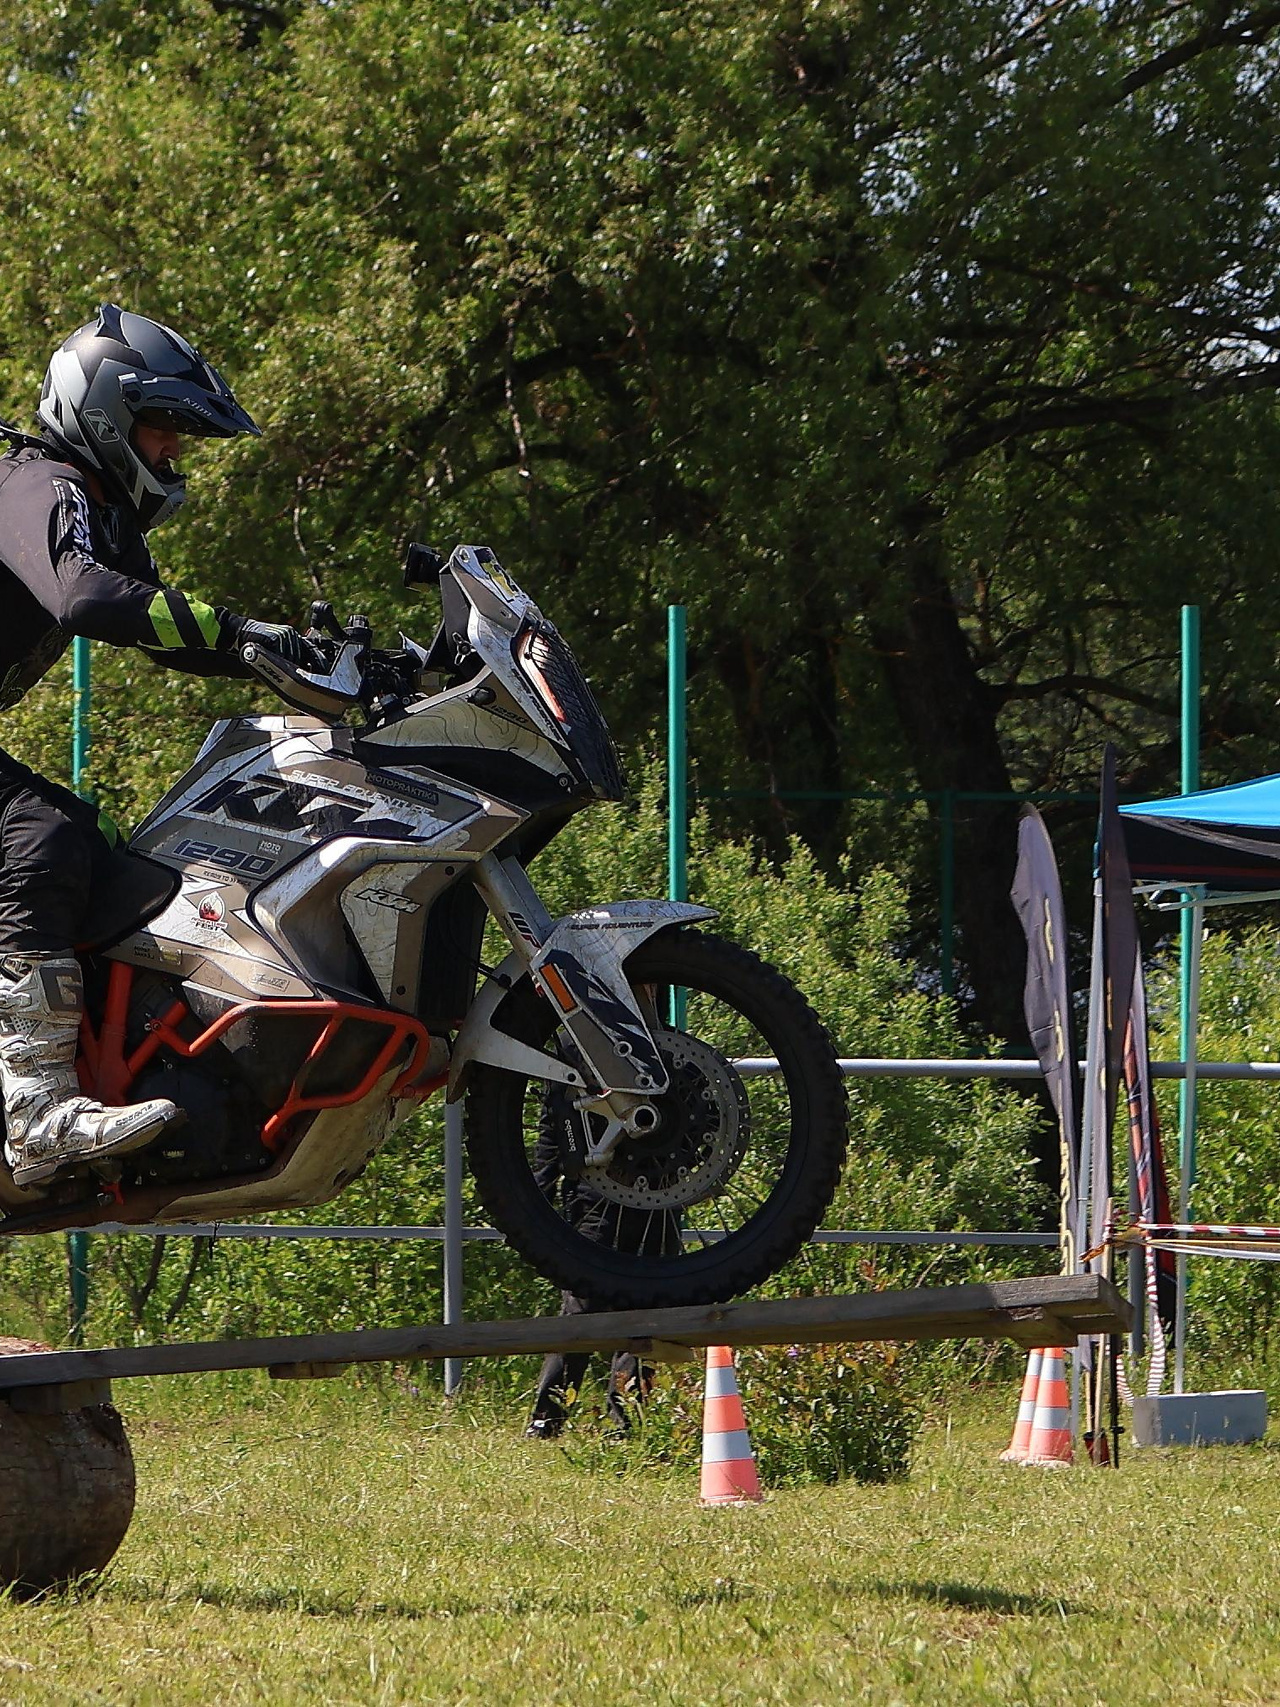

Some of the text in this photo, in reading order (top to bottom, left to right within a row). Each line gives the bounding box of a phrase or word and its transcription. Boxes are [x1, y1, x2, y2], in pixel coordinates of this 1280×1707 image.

[291, 769, 435, 816] SUPER ADVENTURE
[369, 773, 438, 802] MOTOPRAKTIKA
[189, 773, 417, 839] KTM
[172, 838, 278, 876] 1290
[260, 840, 281, 852] MOTO
[353, 887, 422, 914] KTM
[564, 1118, 577, 1153] brembo
